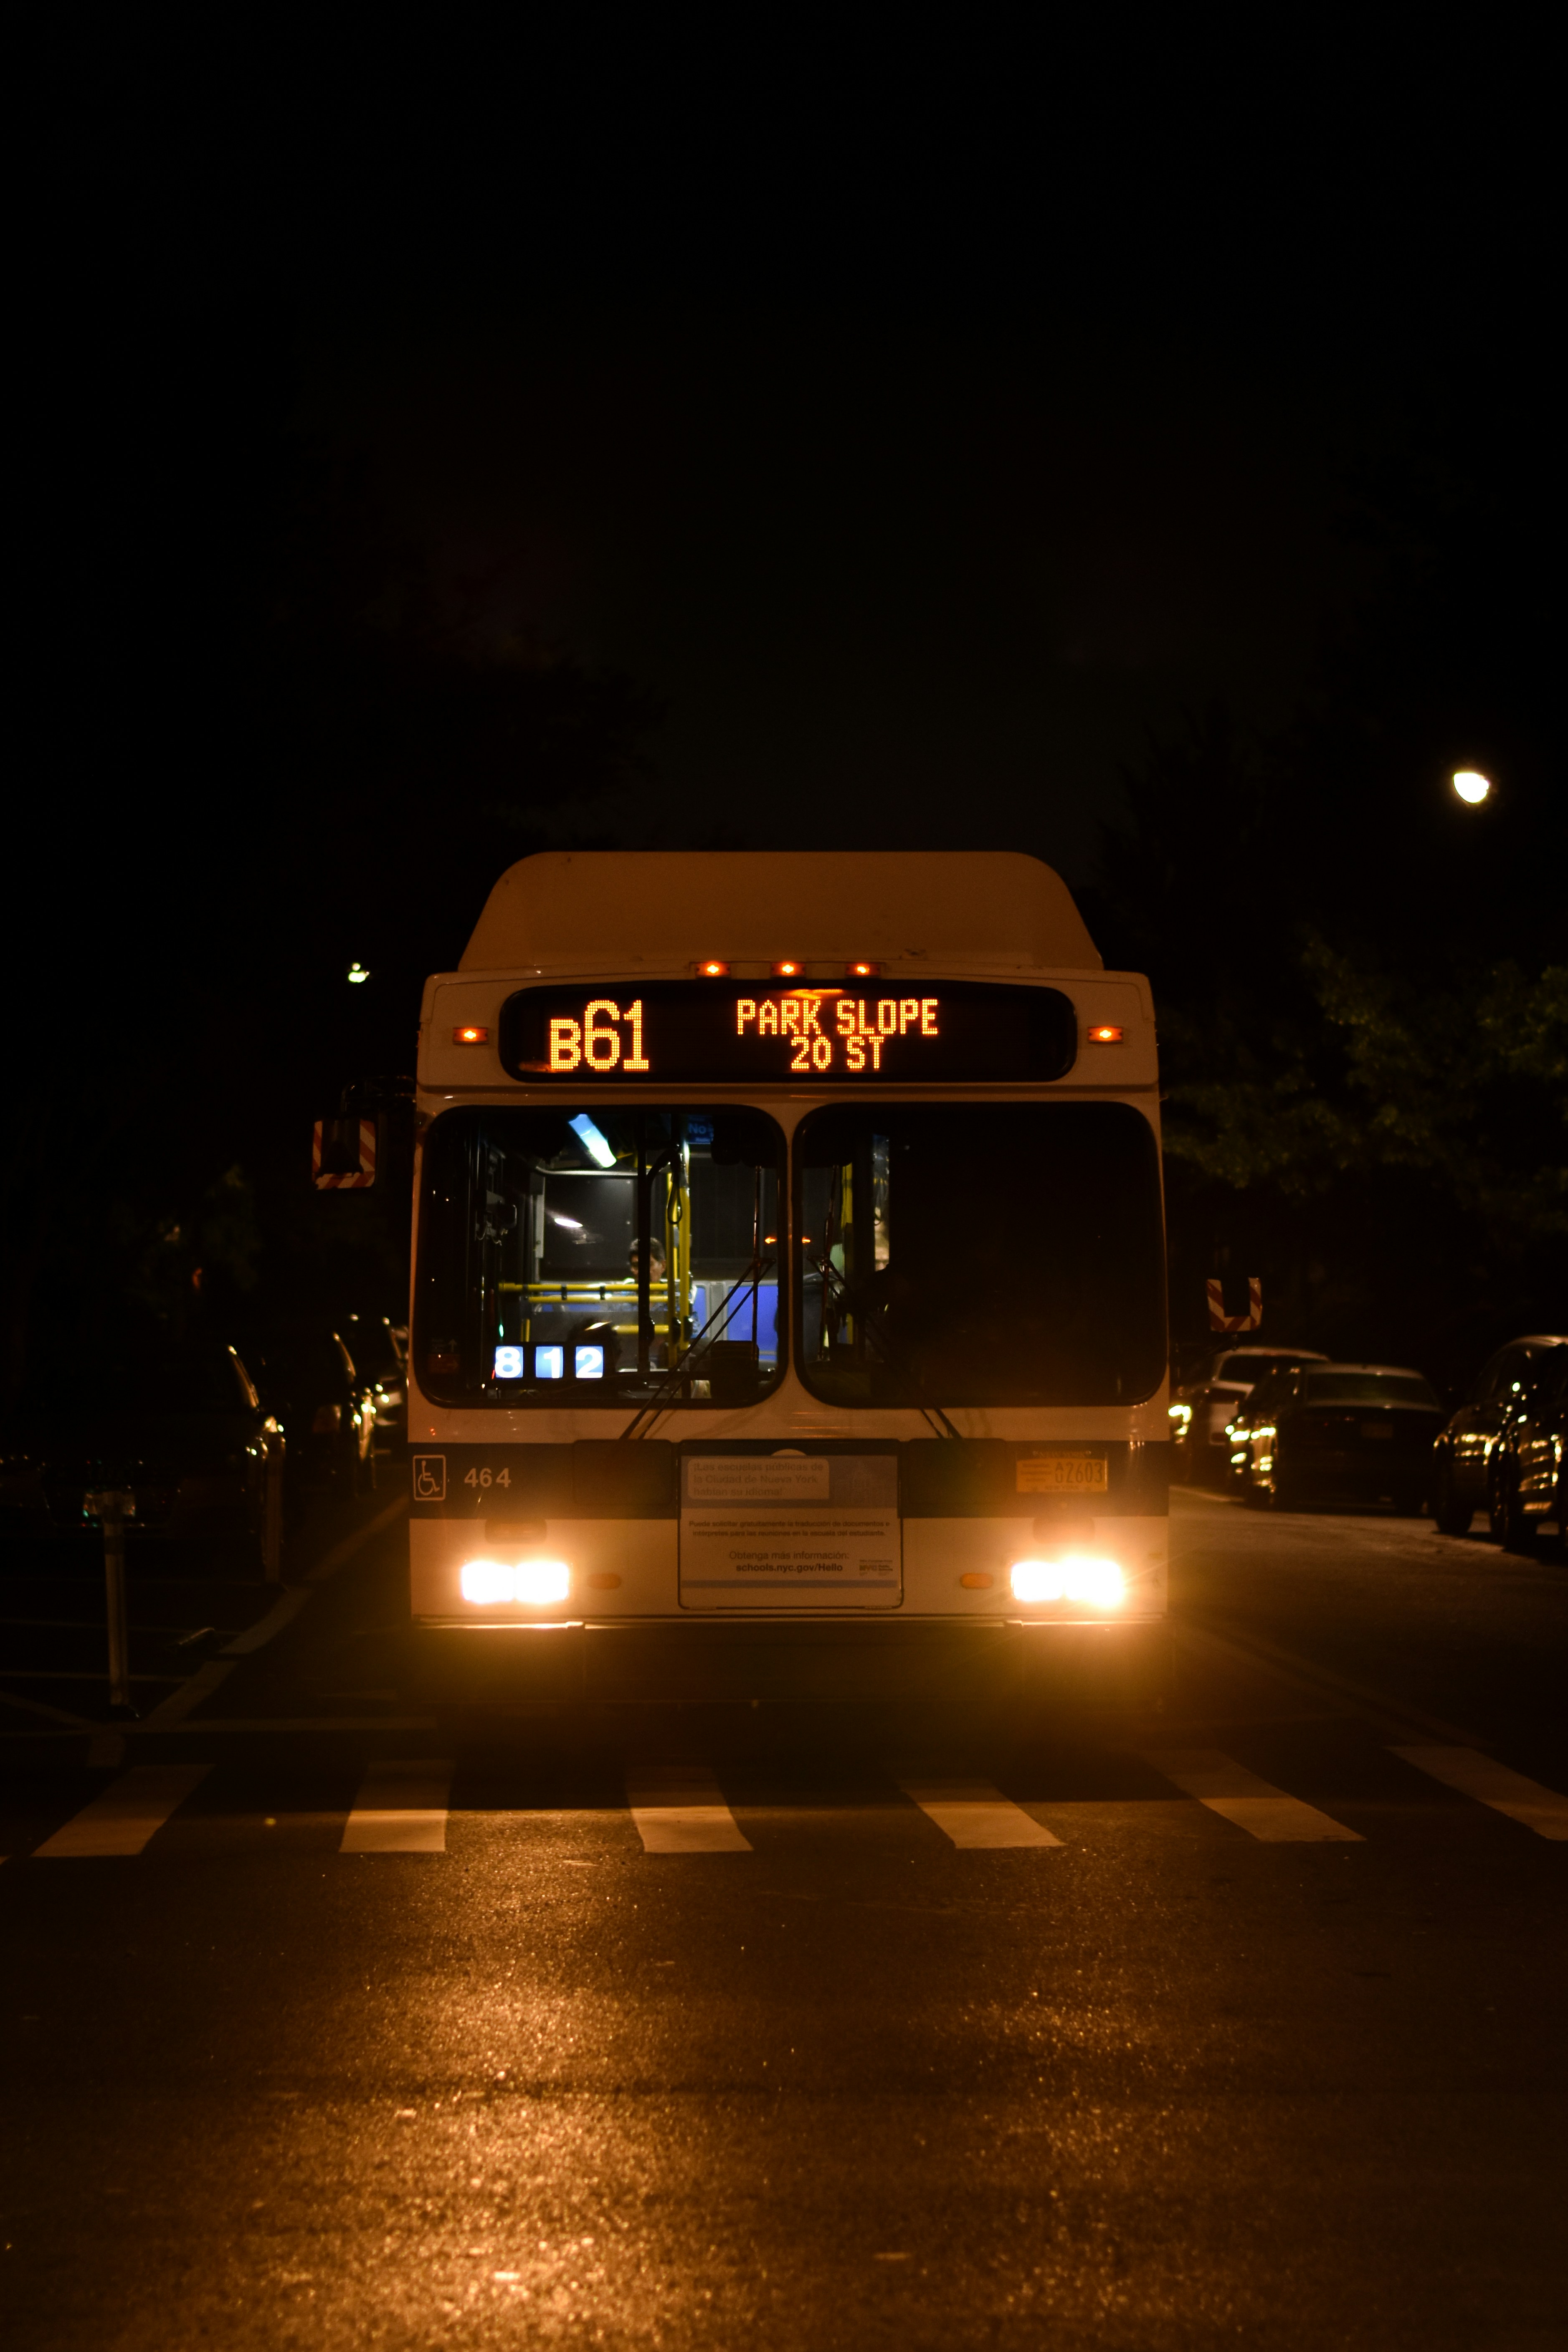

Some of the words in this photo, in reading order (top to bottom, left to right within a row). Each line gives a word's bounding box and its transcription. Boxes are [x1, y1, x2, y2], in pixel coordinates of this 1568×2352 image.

[737, 999, 821, 1035] PARK
[837, 999, 938, 1035] SLOPE
[550, 999, 649, 1070] B61
[790, 1036, 832, 1069] 20
[846, 1036, 884, 1069] ST
[688, 1123, 707, 1134] No
[717, 1463, 762, 1471] escuelas
[766, 1462, 808, 1474] públicas
[811, 1463, 823, 1471] de
[464, 1467, 512, 1488] 464
[694, 1475, 702, 1483] la
[706, 1475, 741, 1483] Ciudad
[745, 1475, 757, 1483] de
[760, 1475, 792, 1483] Nueva
[795, 1475, 818, 1483] York
[694, 1487, 727, 1496] hablan
[746, 1487, 783, 1496] idioma!
[729, 1551, 769, 1561] Obtenga
[771, 1551, 790, 1559] más
[793, 1551, 849, 1560] información:
[736, 1563, 843, 1573] schools.nyc.gov/Hello
